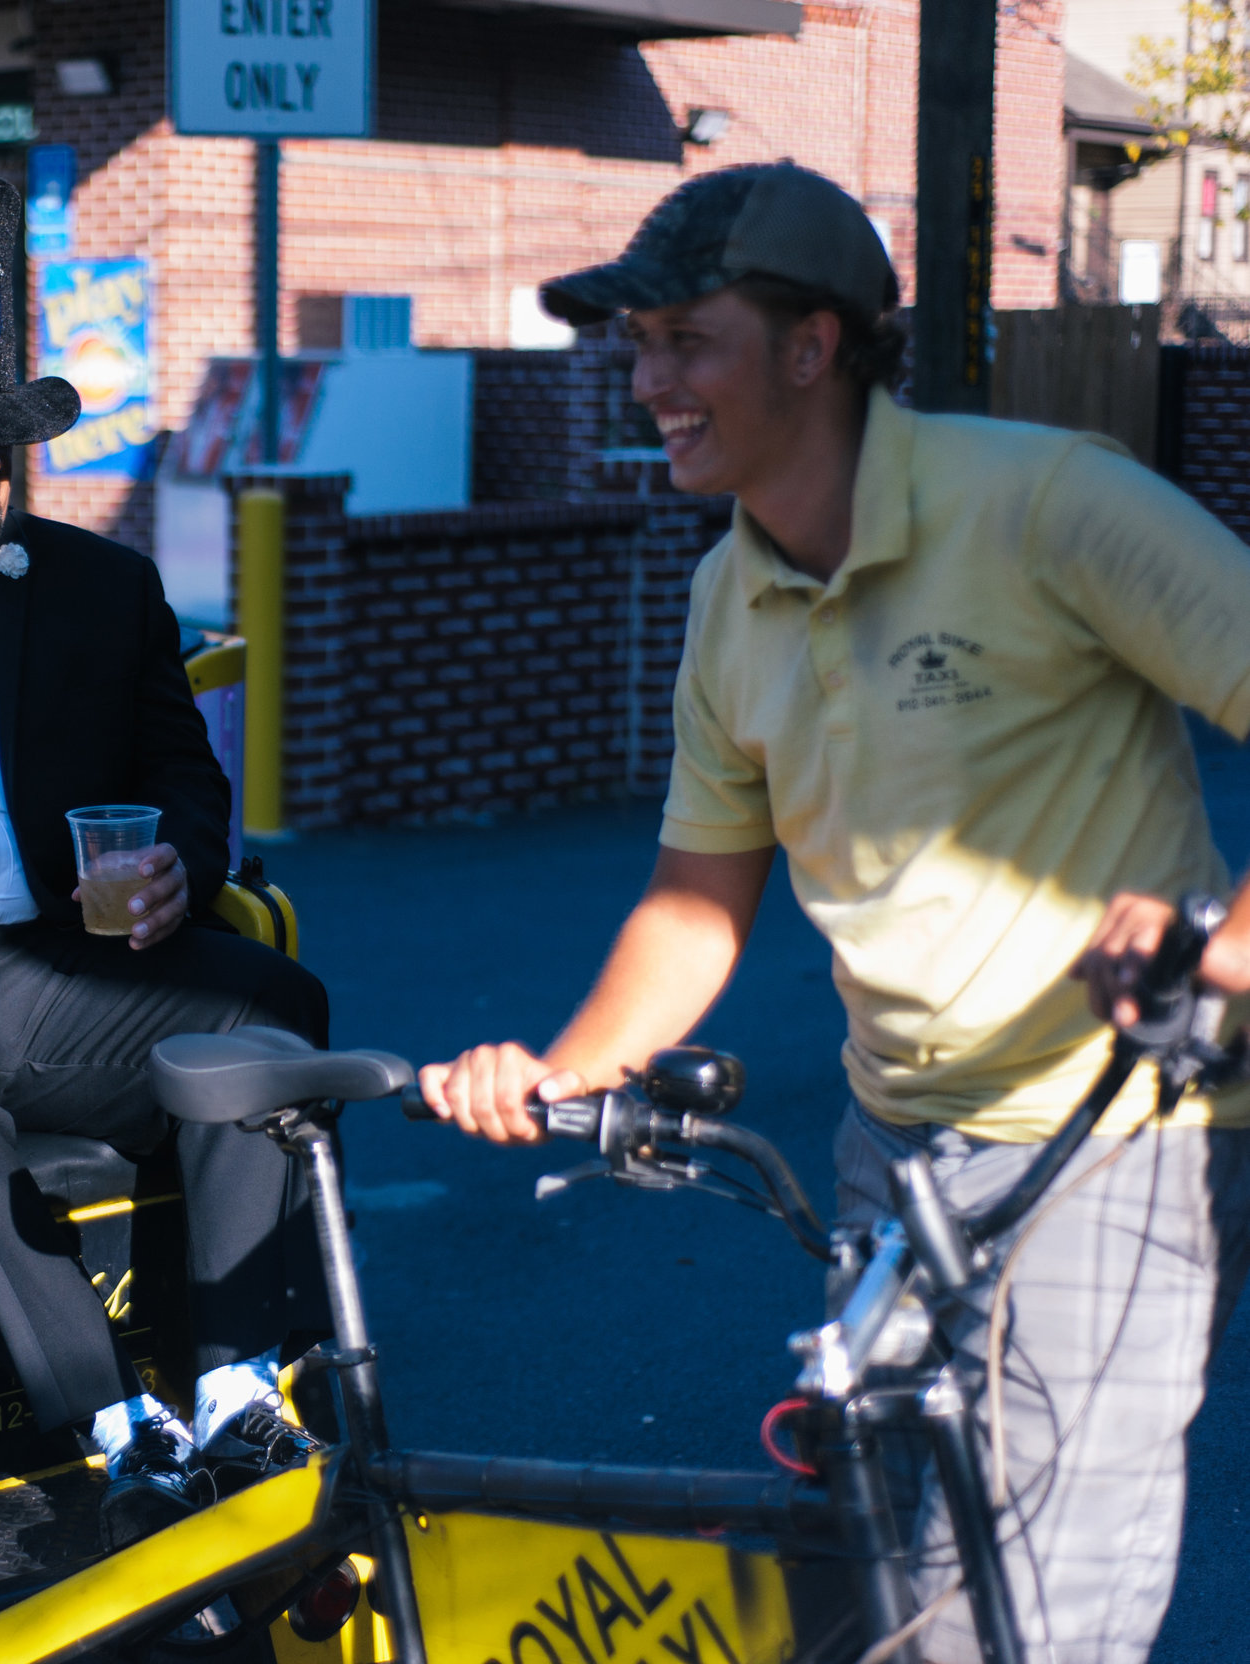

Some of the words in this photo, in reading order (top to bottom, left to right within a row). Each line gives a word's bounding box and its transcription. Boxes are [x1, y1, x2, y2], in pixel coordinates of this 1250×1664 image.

[220, 0, 334, 38] ENTER
[224, 61, 321, 113] ONLY
[888, 632, 935, 669] ROYAL
[936, 632, 986, 657] BIKE
[913, 668, 959, 686] TAXI
